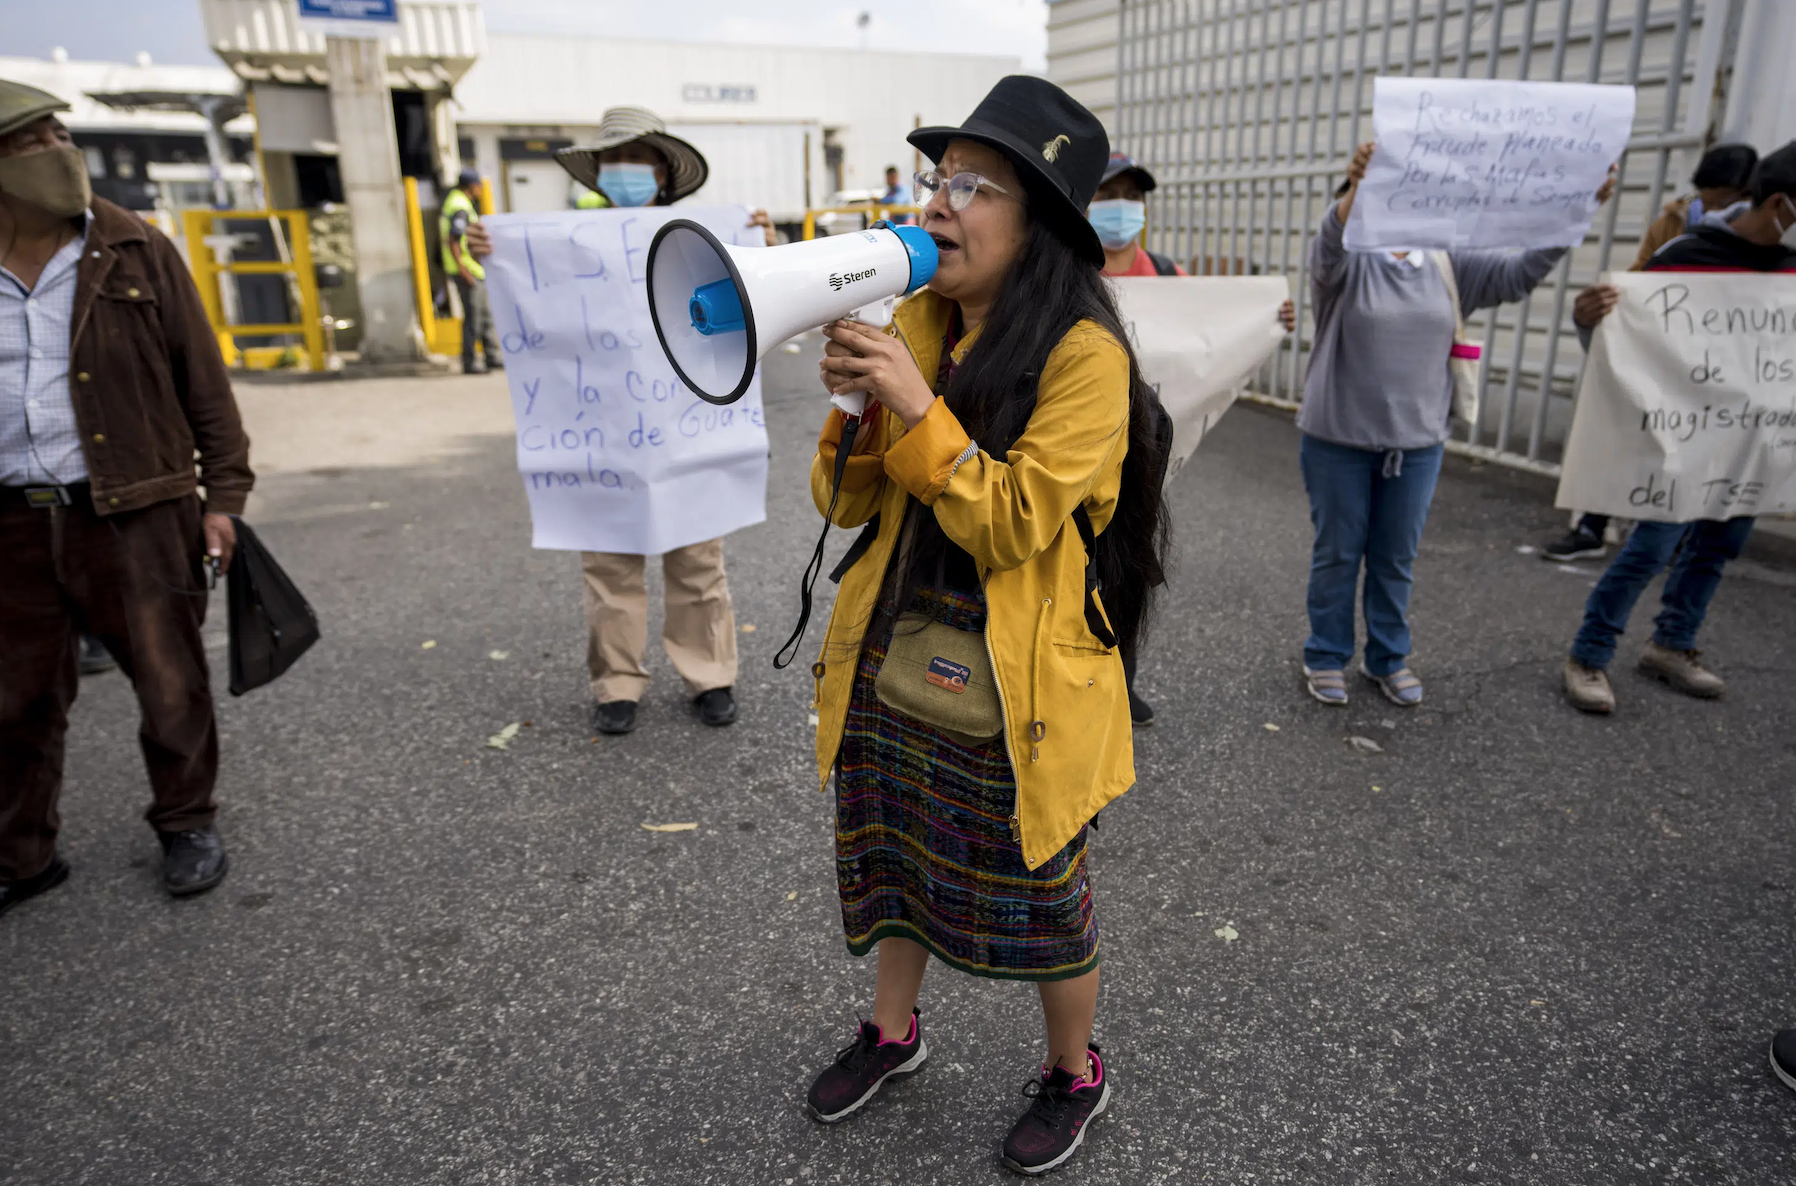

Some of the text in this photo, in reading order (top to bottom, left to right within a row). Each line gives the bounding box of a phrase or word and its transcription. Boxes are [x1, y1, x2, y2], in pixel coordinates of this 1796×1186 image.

[1572, 103, 1597, 128] el
[843, 267, 877, 285] Steren
[501, 294, 643, 354] de las
[575, 354, 600, 404] la
[1689, 345, 1793, 385] de los
[628, 411, 665, 449] de
[1629, 472, 1676, 512] del
